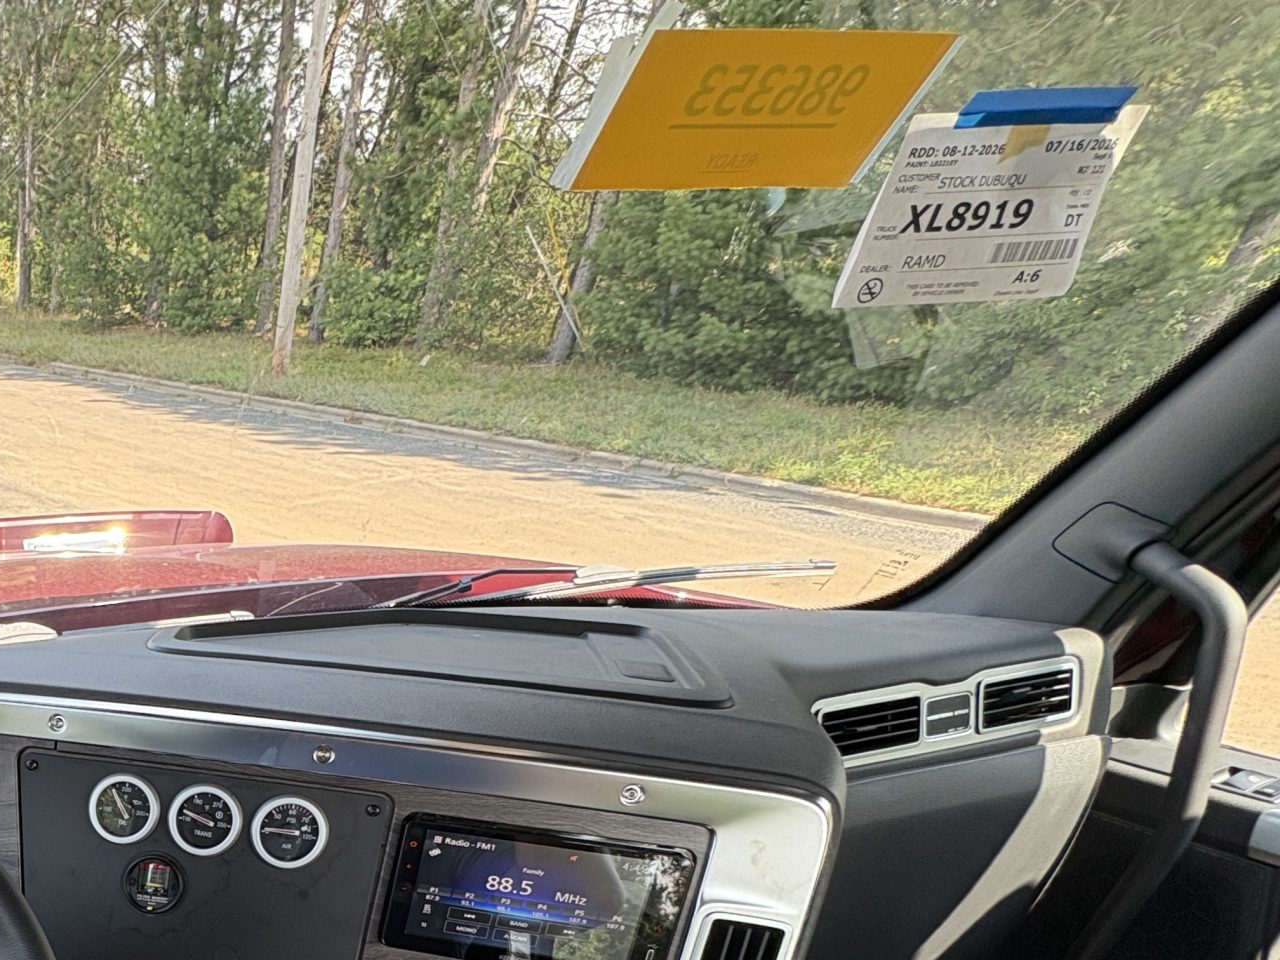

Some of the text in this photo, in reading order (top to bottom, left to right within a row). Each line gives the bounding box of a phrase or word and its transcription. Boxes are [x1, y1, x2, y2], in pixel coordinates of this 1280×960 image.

[908, 143, 1007, 158] RDD: 08-12-2026
[1045, 138, 1119, 154] 07/16/2026
[898, 172, 1028, 189] CUSTOMER STOCK DUBUQU
[898, 198, 1034, 234] XL8919
[1064, 213, 1084, 227] DT
[859, 254, 947, 274] DEALER: RAMD
[1011, 269, 1042, 284] A:6
[445, 837, 471, 848] Radio
[476, 841, 496, 852] FM1
[523, 867, 545, 877] Family
[485, 875, 588, 907] 88.5 MHz
[429, 886, 439, 894] P1
[464, 892, 475, 900] P2
[537, 903, 548, 911] P4
[574, 909, 585, 917] P5
[455, 925, 478, 934] MONO
[509, 920, 528, 929] BAND
